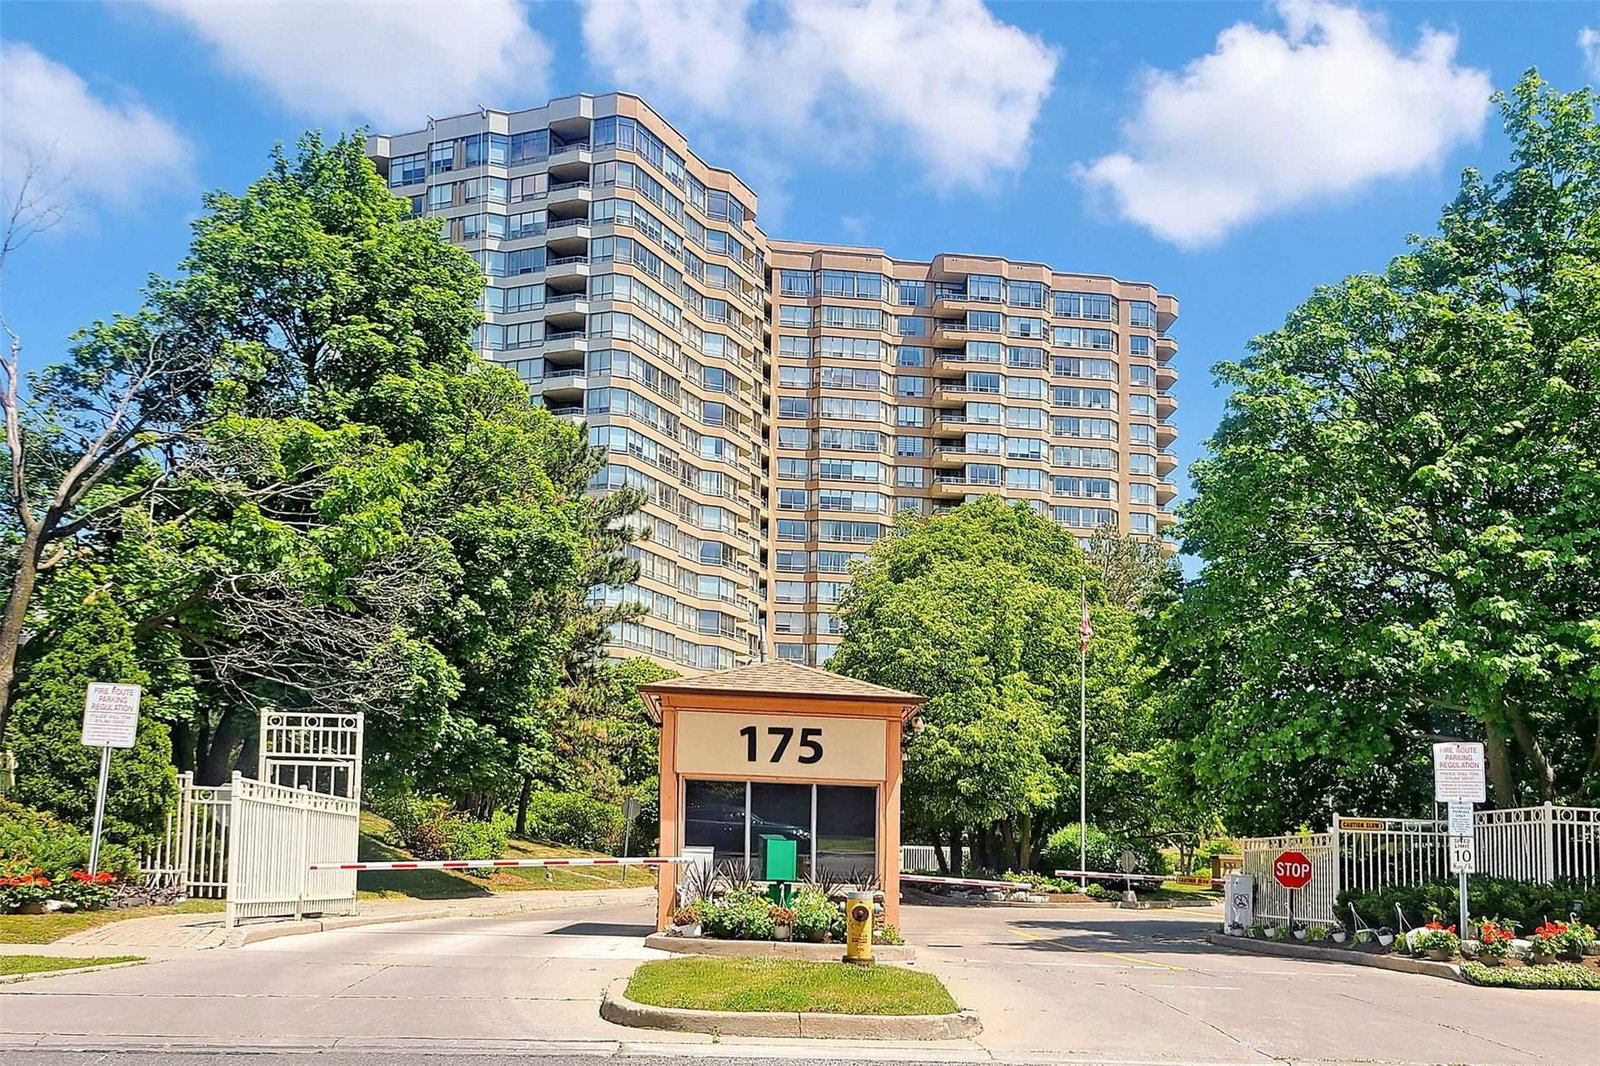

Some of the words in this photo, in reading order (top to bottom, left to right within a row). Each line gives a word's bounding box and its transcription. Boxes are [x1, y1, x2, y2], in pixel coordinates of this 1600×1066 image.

[94, 687, 109, 695] FIRE
[111, 687, 134, 696] ROUTE
[98, 695, 128, 704] PARKING
[91, 703, 134, 712] REGULATION
[740, 726, 823, 764] 175
[1454, 849, 1472, 863] 10
[1276, 861, 1310, 878] STOP
